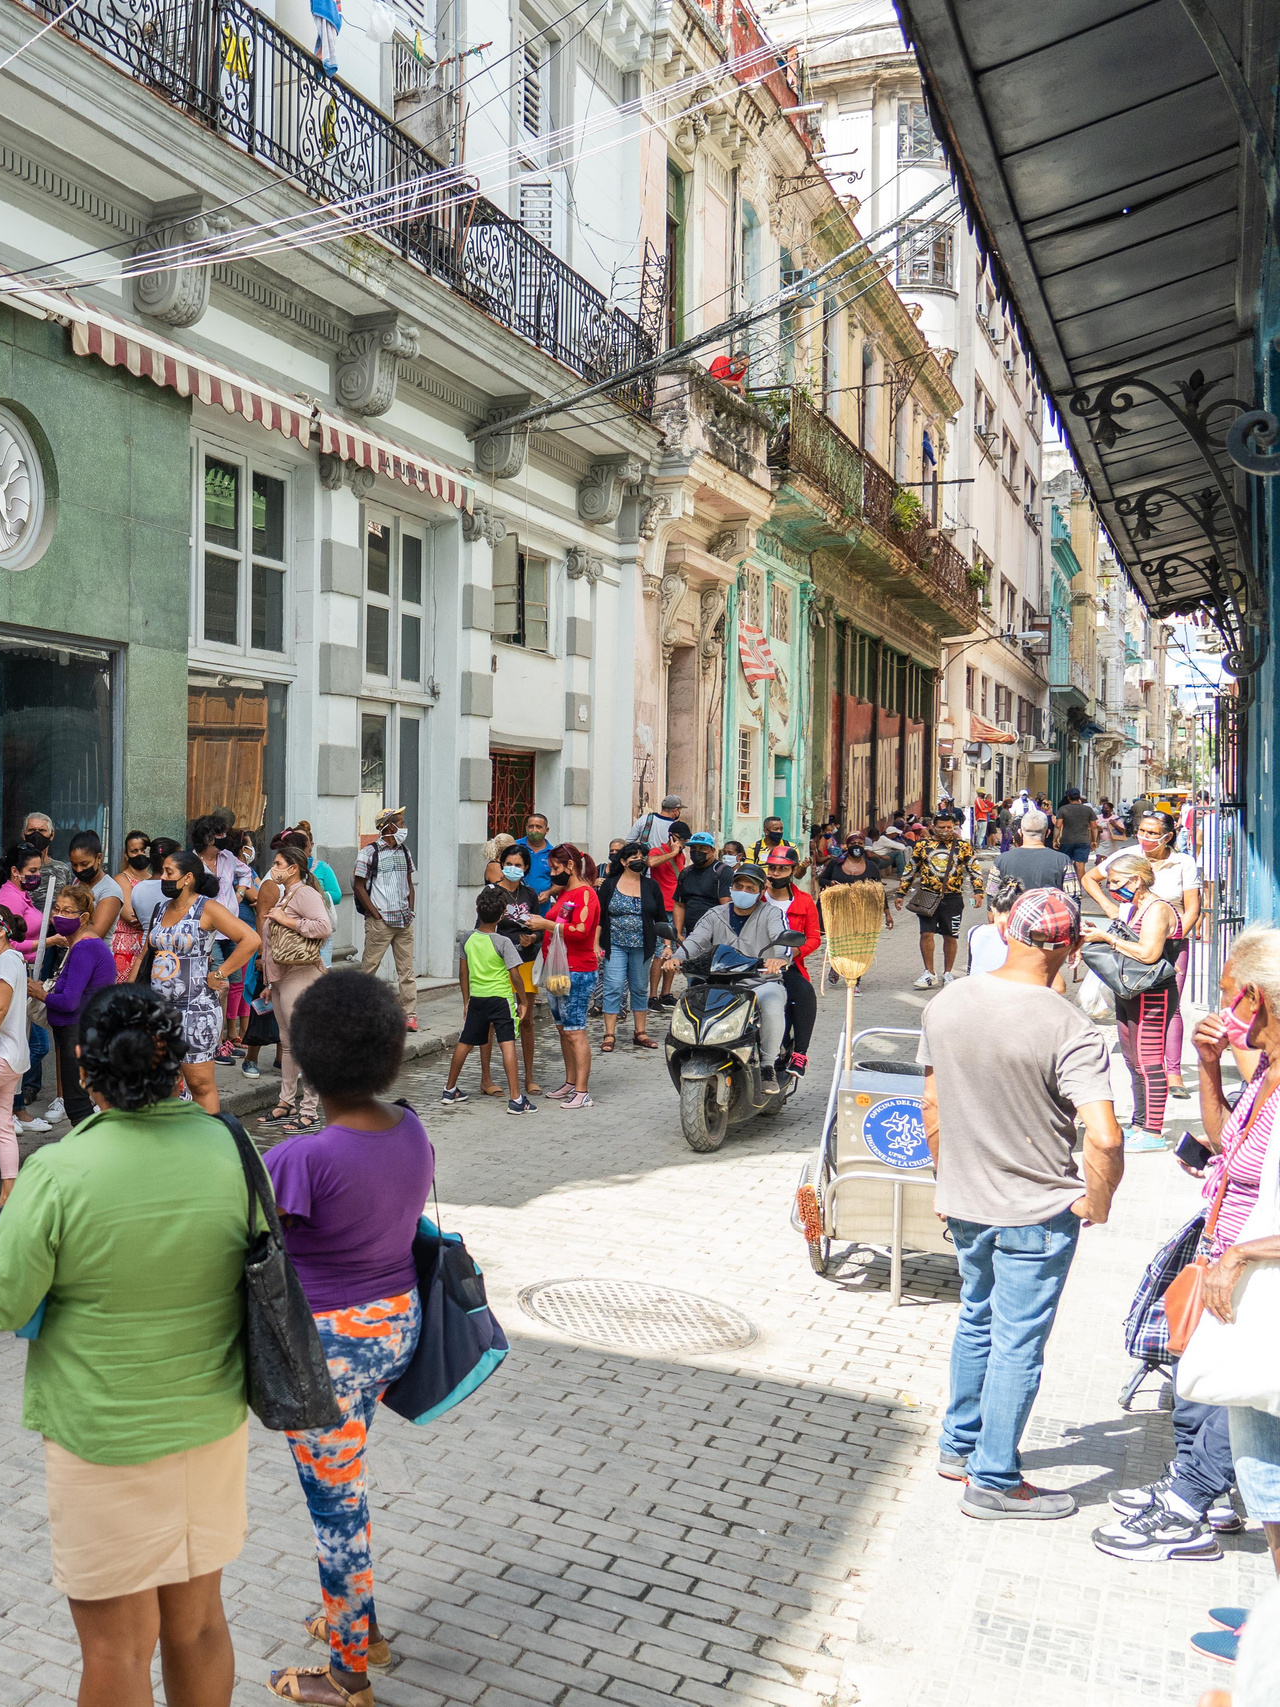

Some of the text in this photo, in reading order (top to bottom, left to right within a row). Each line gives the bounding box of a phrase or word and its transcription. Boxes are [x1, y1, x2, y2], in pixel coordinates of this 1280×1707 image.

[378, 453, 391, 471] LA
[869, 1100, 896, 1119] OFICINA
[865, 1133, 887, 1161] HIGIENE
[886, 1157, 897, 1166] DE
[908, 1153, 933, 1167] CIUDA
